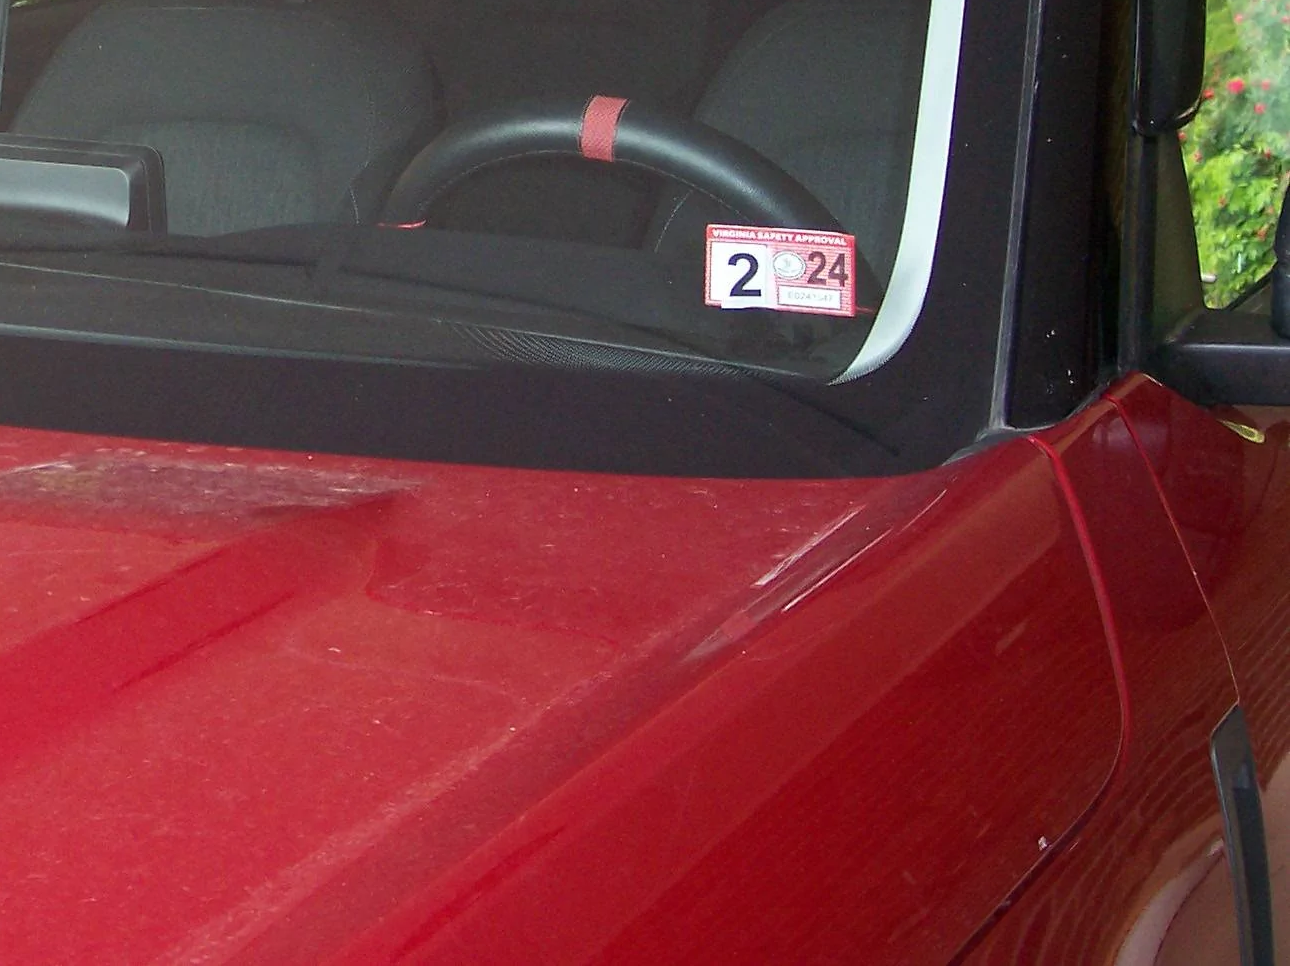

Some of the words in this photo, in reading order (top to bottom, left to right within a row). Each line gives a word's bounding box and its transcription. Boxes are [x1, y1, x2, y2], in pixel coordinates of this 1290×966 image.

[712, 229, 756, 240] VIRGINIA
[757, 231, 793, 242] SAFETY
[795, 234, 847, 246] APPROVAL
[727, 252, 762, 297] 2
[807, 251, 849, 287] 24
